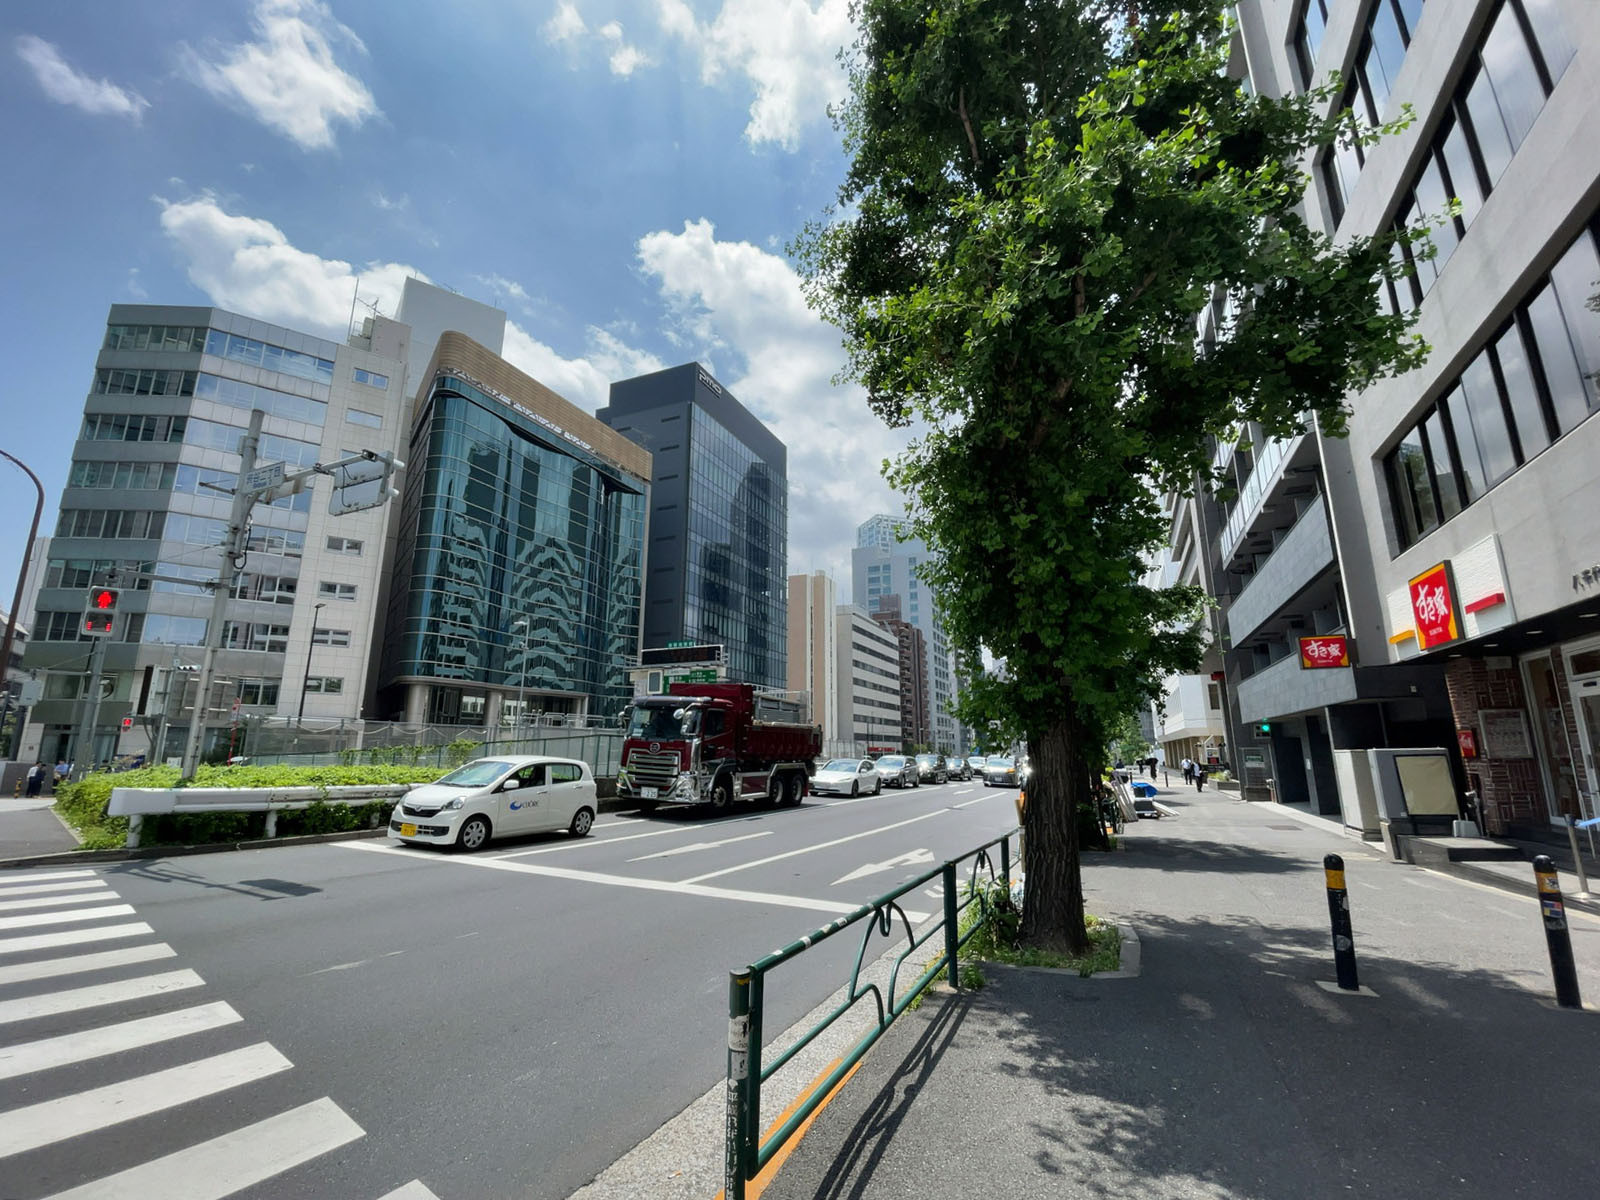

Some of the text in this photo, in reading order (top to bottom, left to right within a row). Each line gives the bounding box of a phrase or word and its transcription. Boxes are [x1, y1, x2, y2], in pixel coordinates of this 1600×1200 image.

[1416, 584, 1448, 625] すき家
[1305, 640, 1342, 659] すき家
